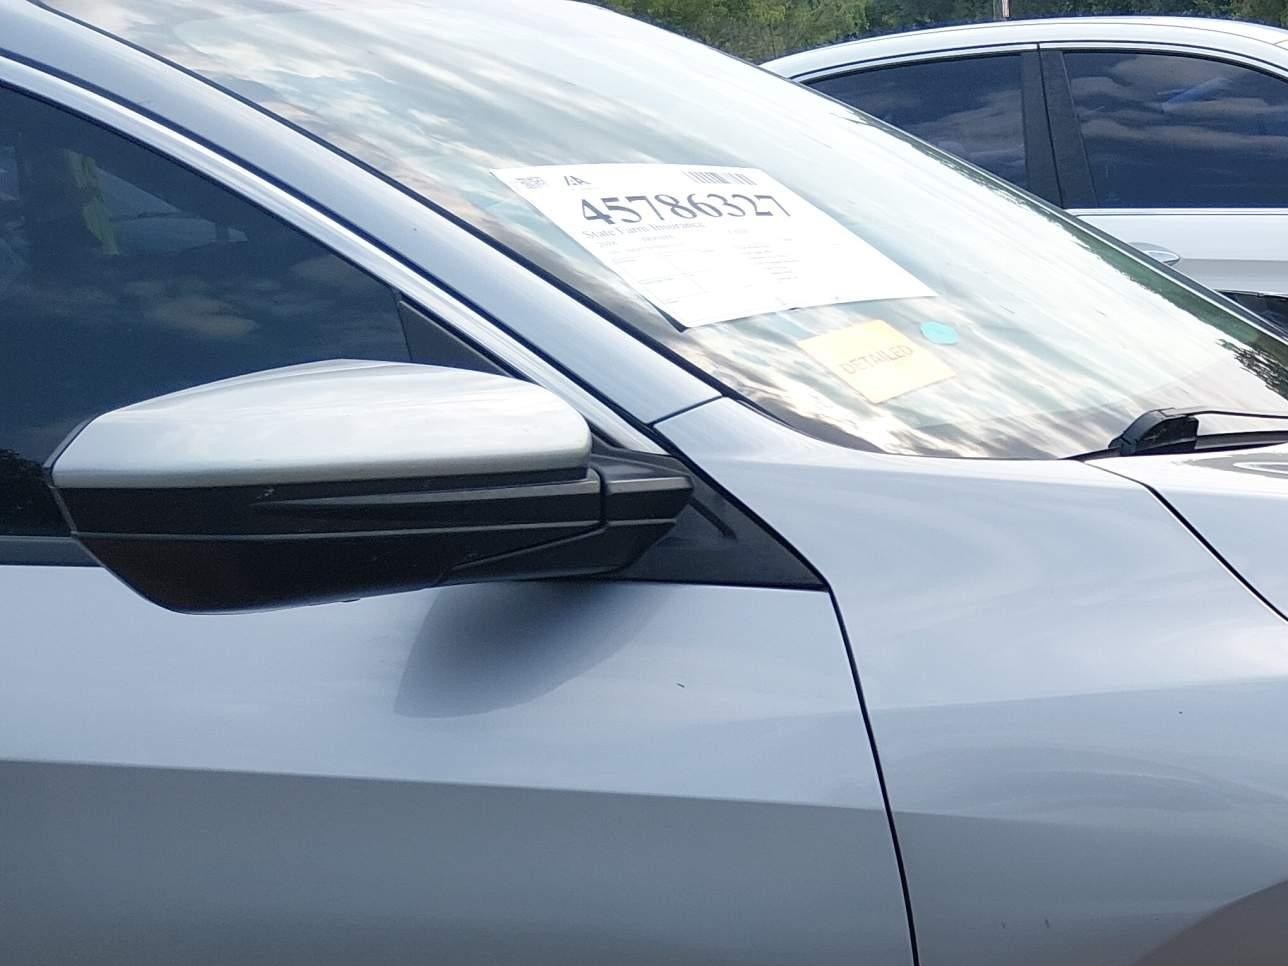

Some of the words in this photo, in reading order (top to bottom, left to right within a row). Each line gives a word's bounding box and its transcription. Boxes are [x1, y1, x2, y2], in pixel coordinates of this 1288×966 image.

[581, 193, 792, 225] 45786327
[581, 227, 616, 240] State
[616, 225, 650, 237] Farm
[841, 344, 913, 375] DETAILED
